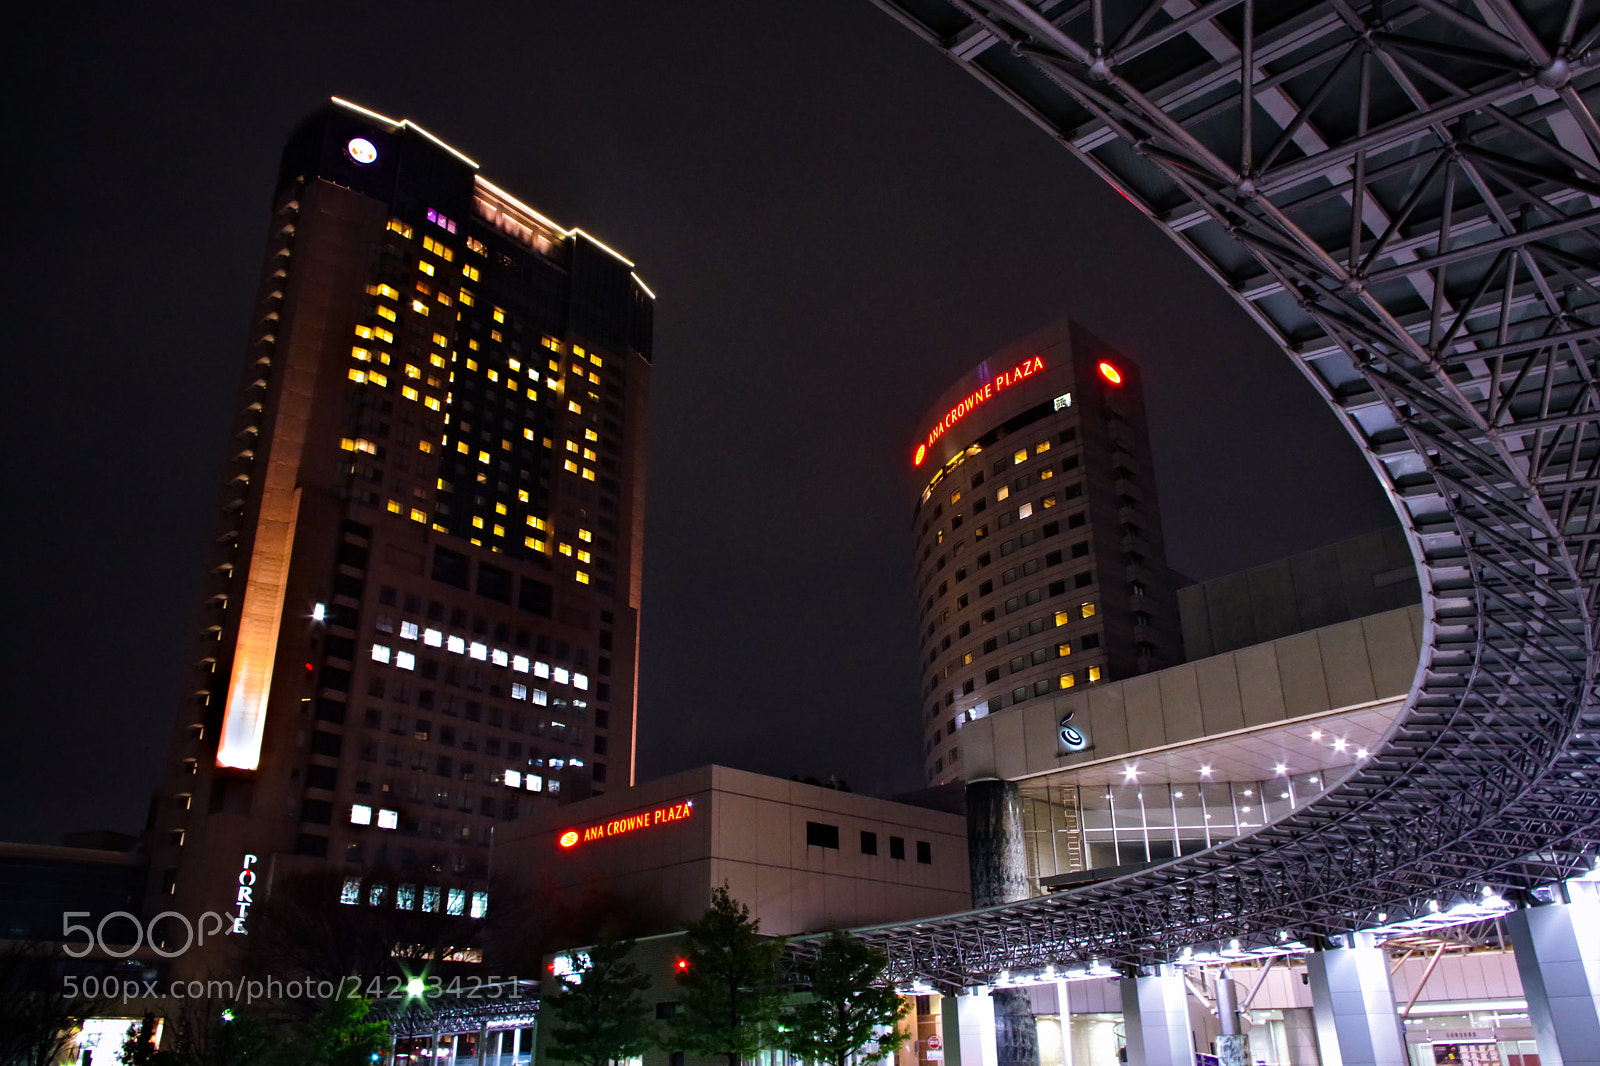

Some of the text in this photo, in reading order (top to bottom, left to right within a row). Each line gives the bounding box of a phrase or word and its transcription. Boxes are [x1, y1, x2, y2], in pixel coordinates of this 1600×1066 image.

[928, 356, 1044, 447] ANA CROWNE PLAZA
[584, 803, 691, 842] ANA CROWNE PLAZA
[233, 854, 258, 933] PORTE
